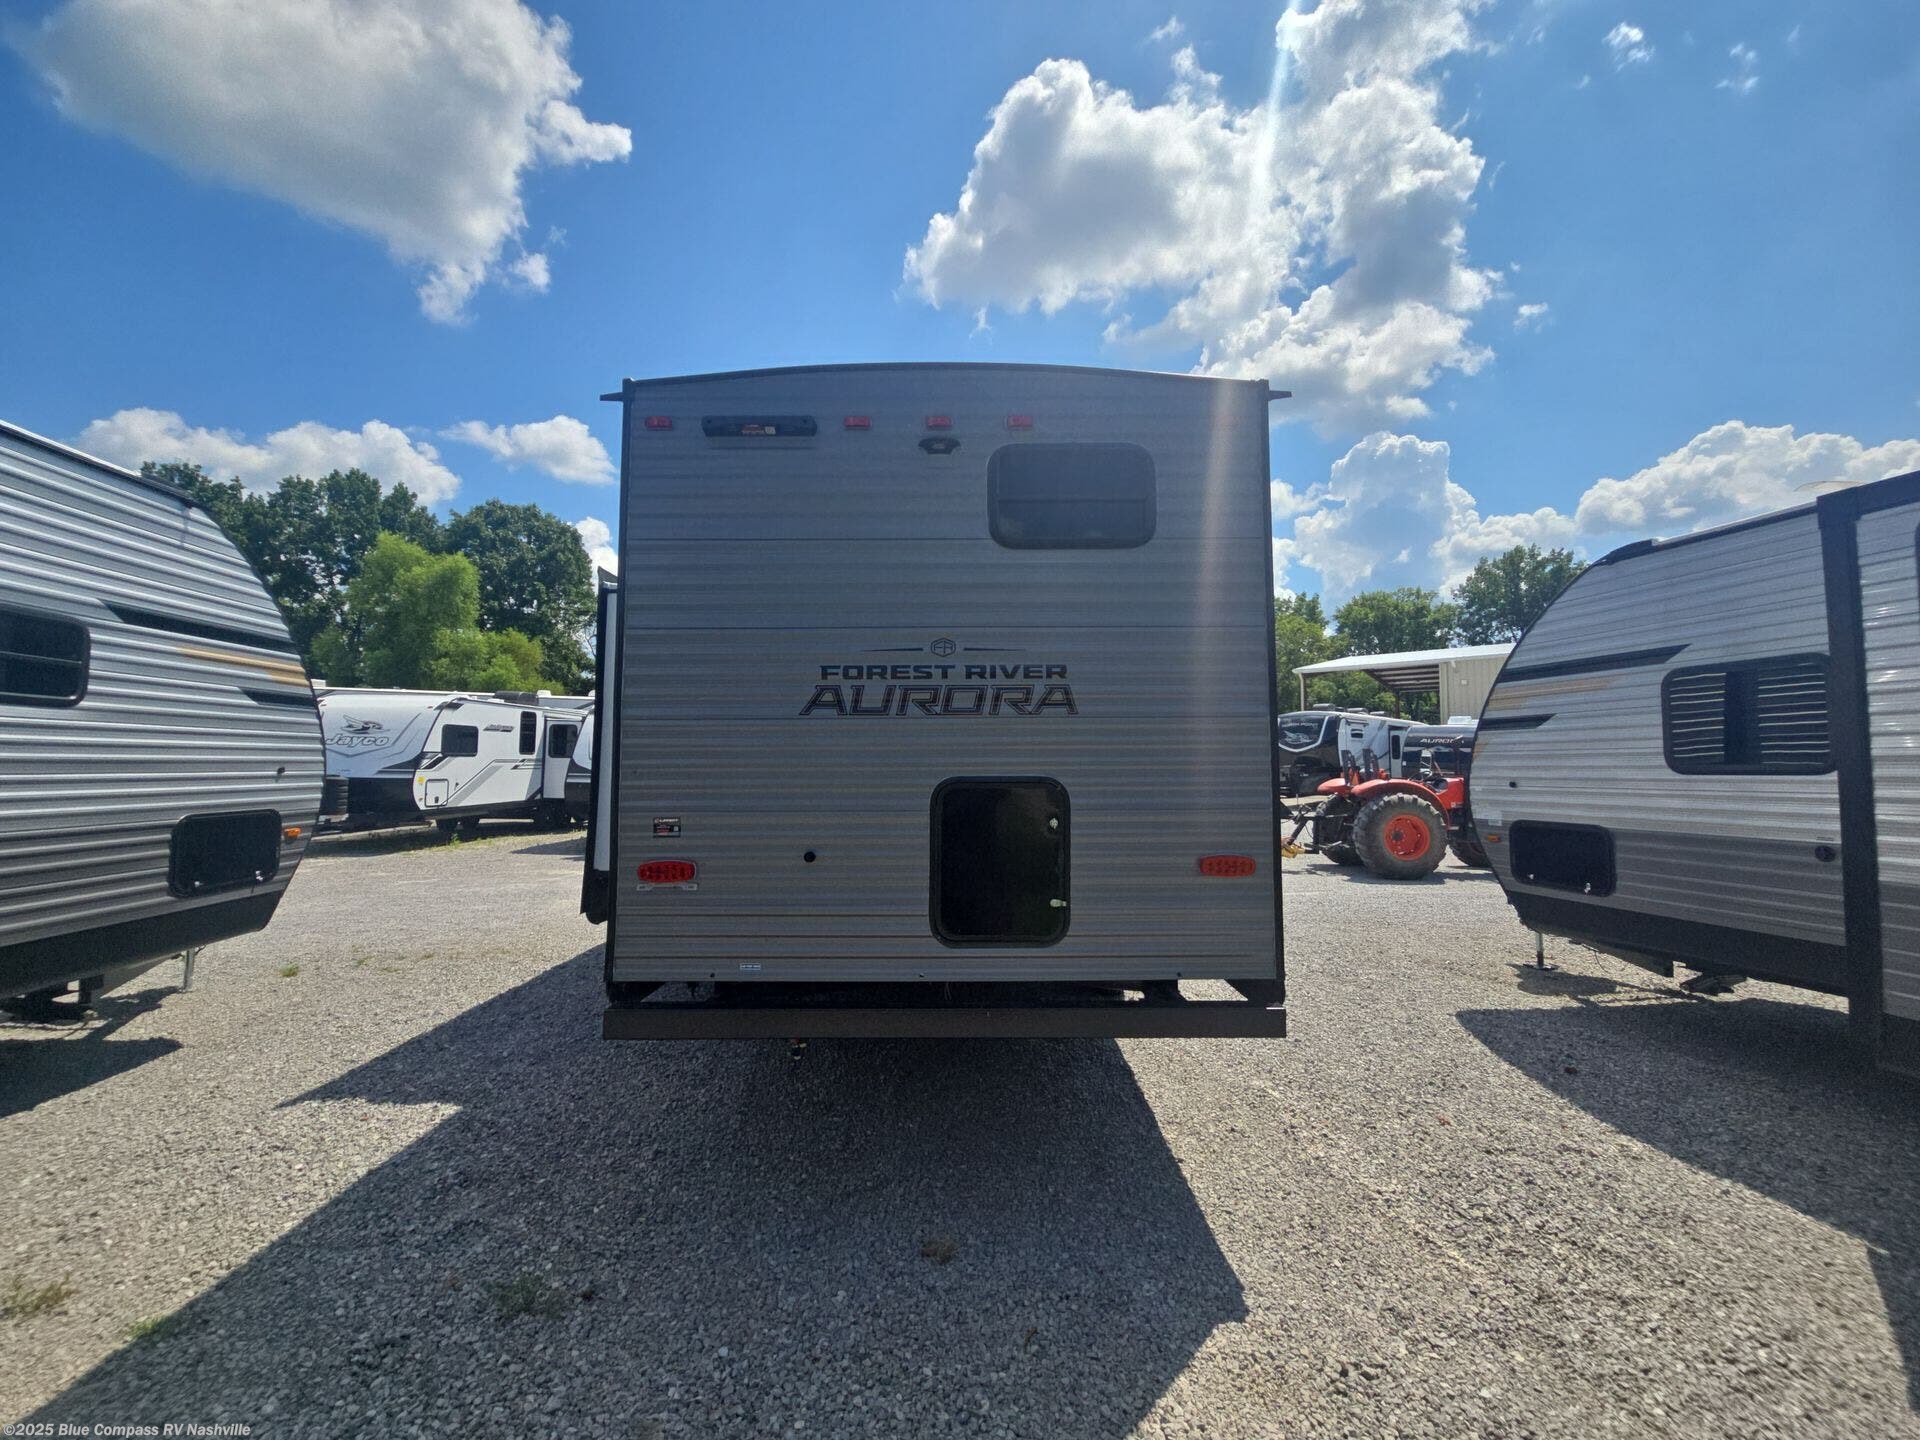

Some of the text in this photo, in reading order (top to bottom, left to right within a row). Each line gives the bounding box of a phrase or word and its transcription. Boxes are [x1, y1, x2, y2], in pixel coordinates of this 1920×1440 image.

[820, 665, 1068, 680] FOREST RIVER
[799, 684, 1079, 716] AURORA
[325, 733, 389, 748] Jayco
